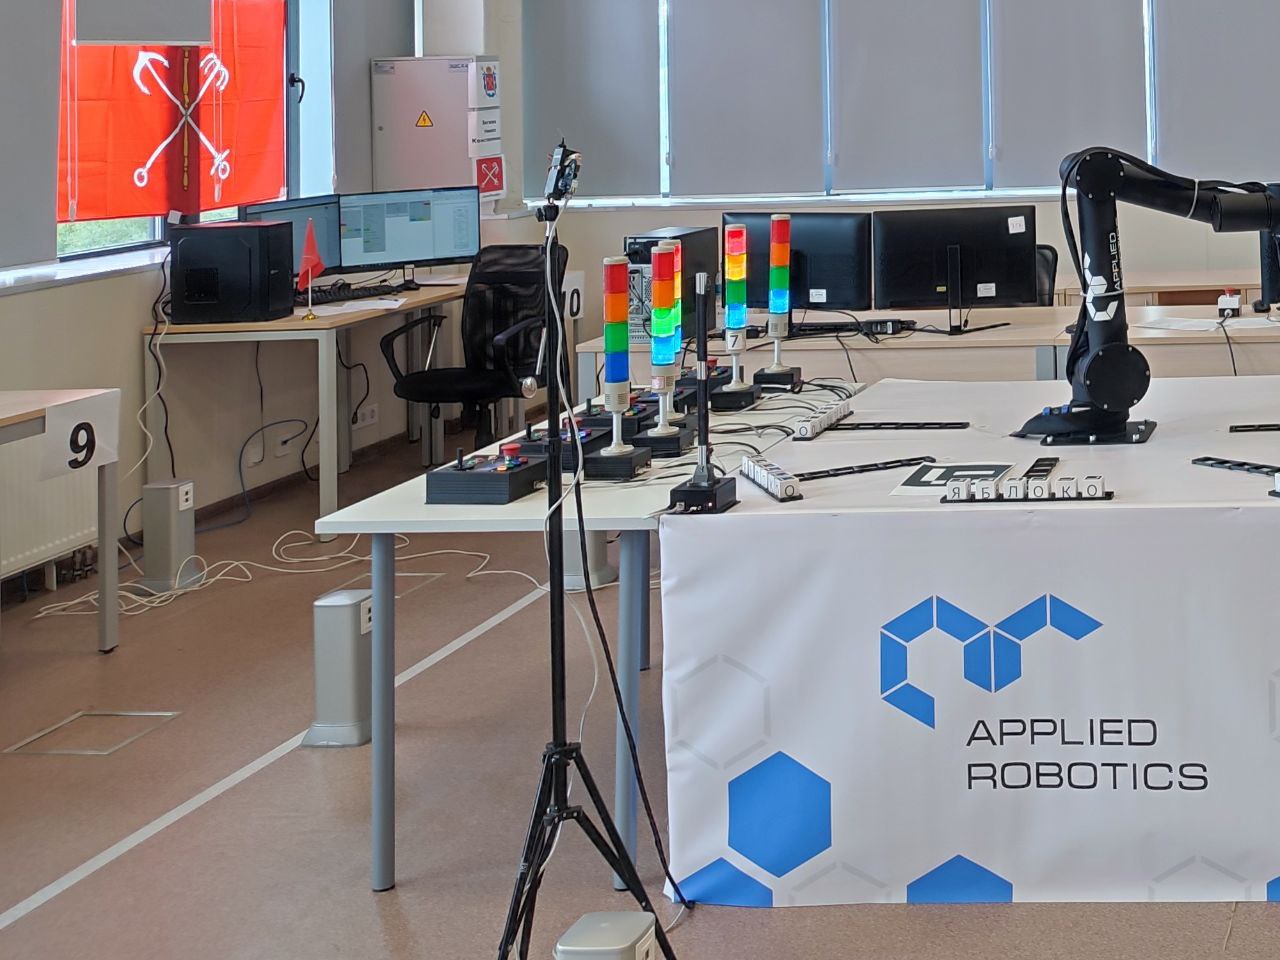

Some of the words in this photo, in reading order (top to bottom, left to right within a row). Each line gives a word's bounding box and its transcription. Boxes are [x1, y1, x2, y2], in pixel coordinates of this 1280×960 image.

[1109, 232, 1121, 290] APPLIED
[730, 334, 739, 348] 7
[68, 421, 96, 470] 9
[951, 483, 1098, 500] ЯБЛОКО
[965, 718, 1158, 747] APPLIED
[966, 761, 1209, 791] ROBOTICS
